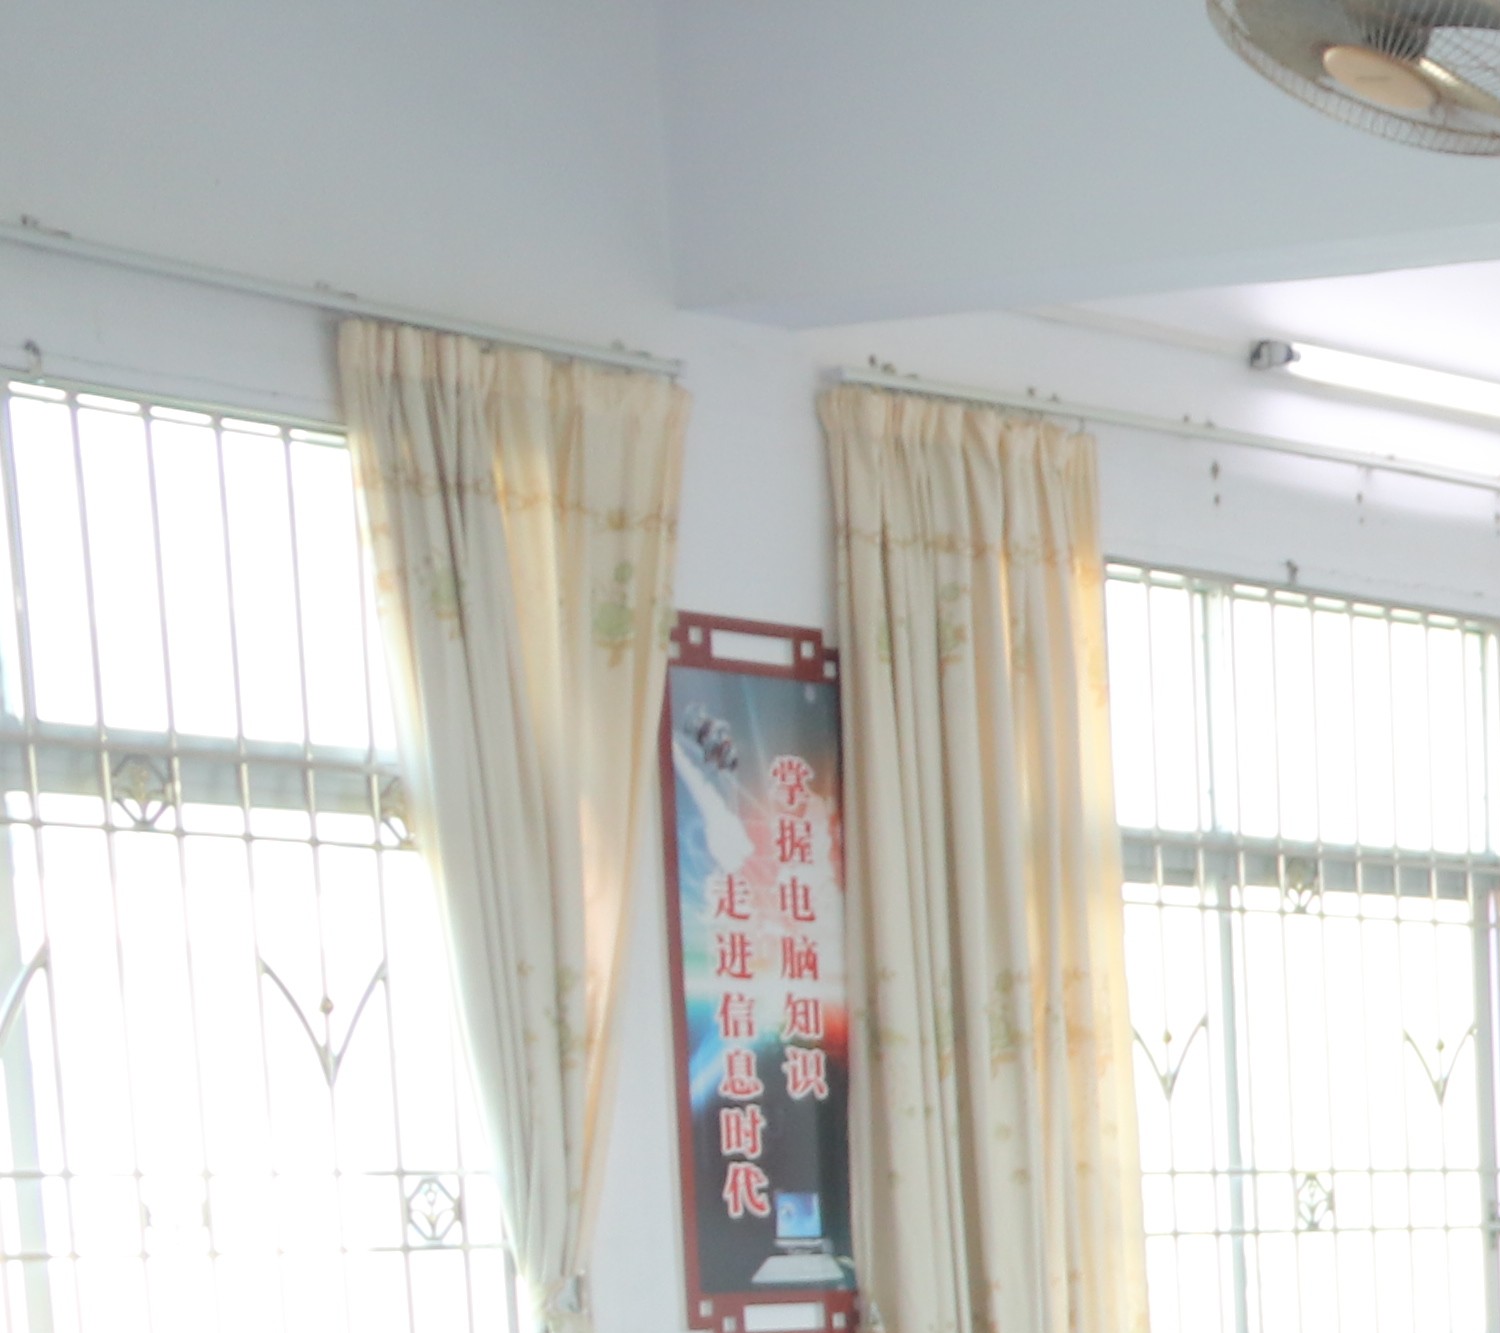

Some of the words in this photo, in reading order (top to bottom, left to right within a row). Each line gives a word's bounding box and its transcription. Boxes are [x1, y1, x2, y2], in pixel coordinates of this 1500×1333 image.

[714, 872, 771, 1218] 走进信息时代
[770, 755, 828, 1098] 掌握电脑知识
